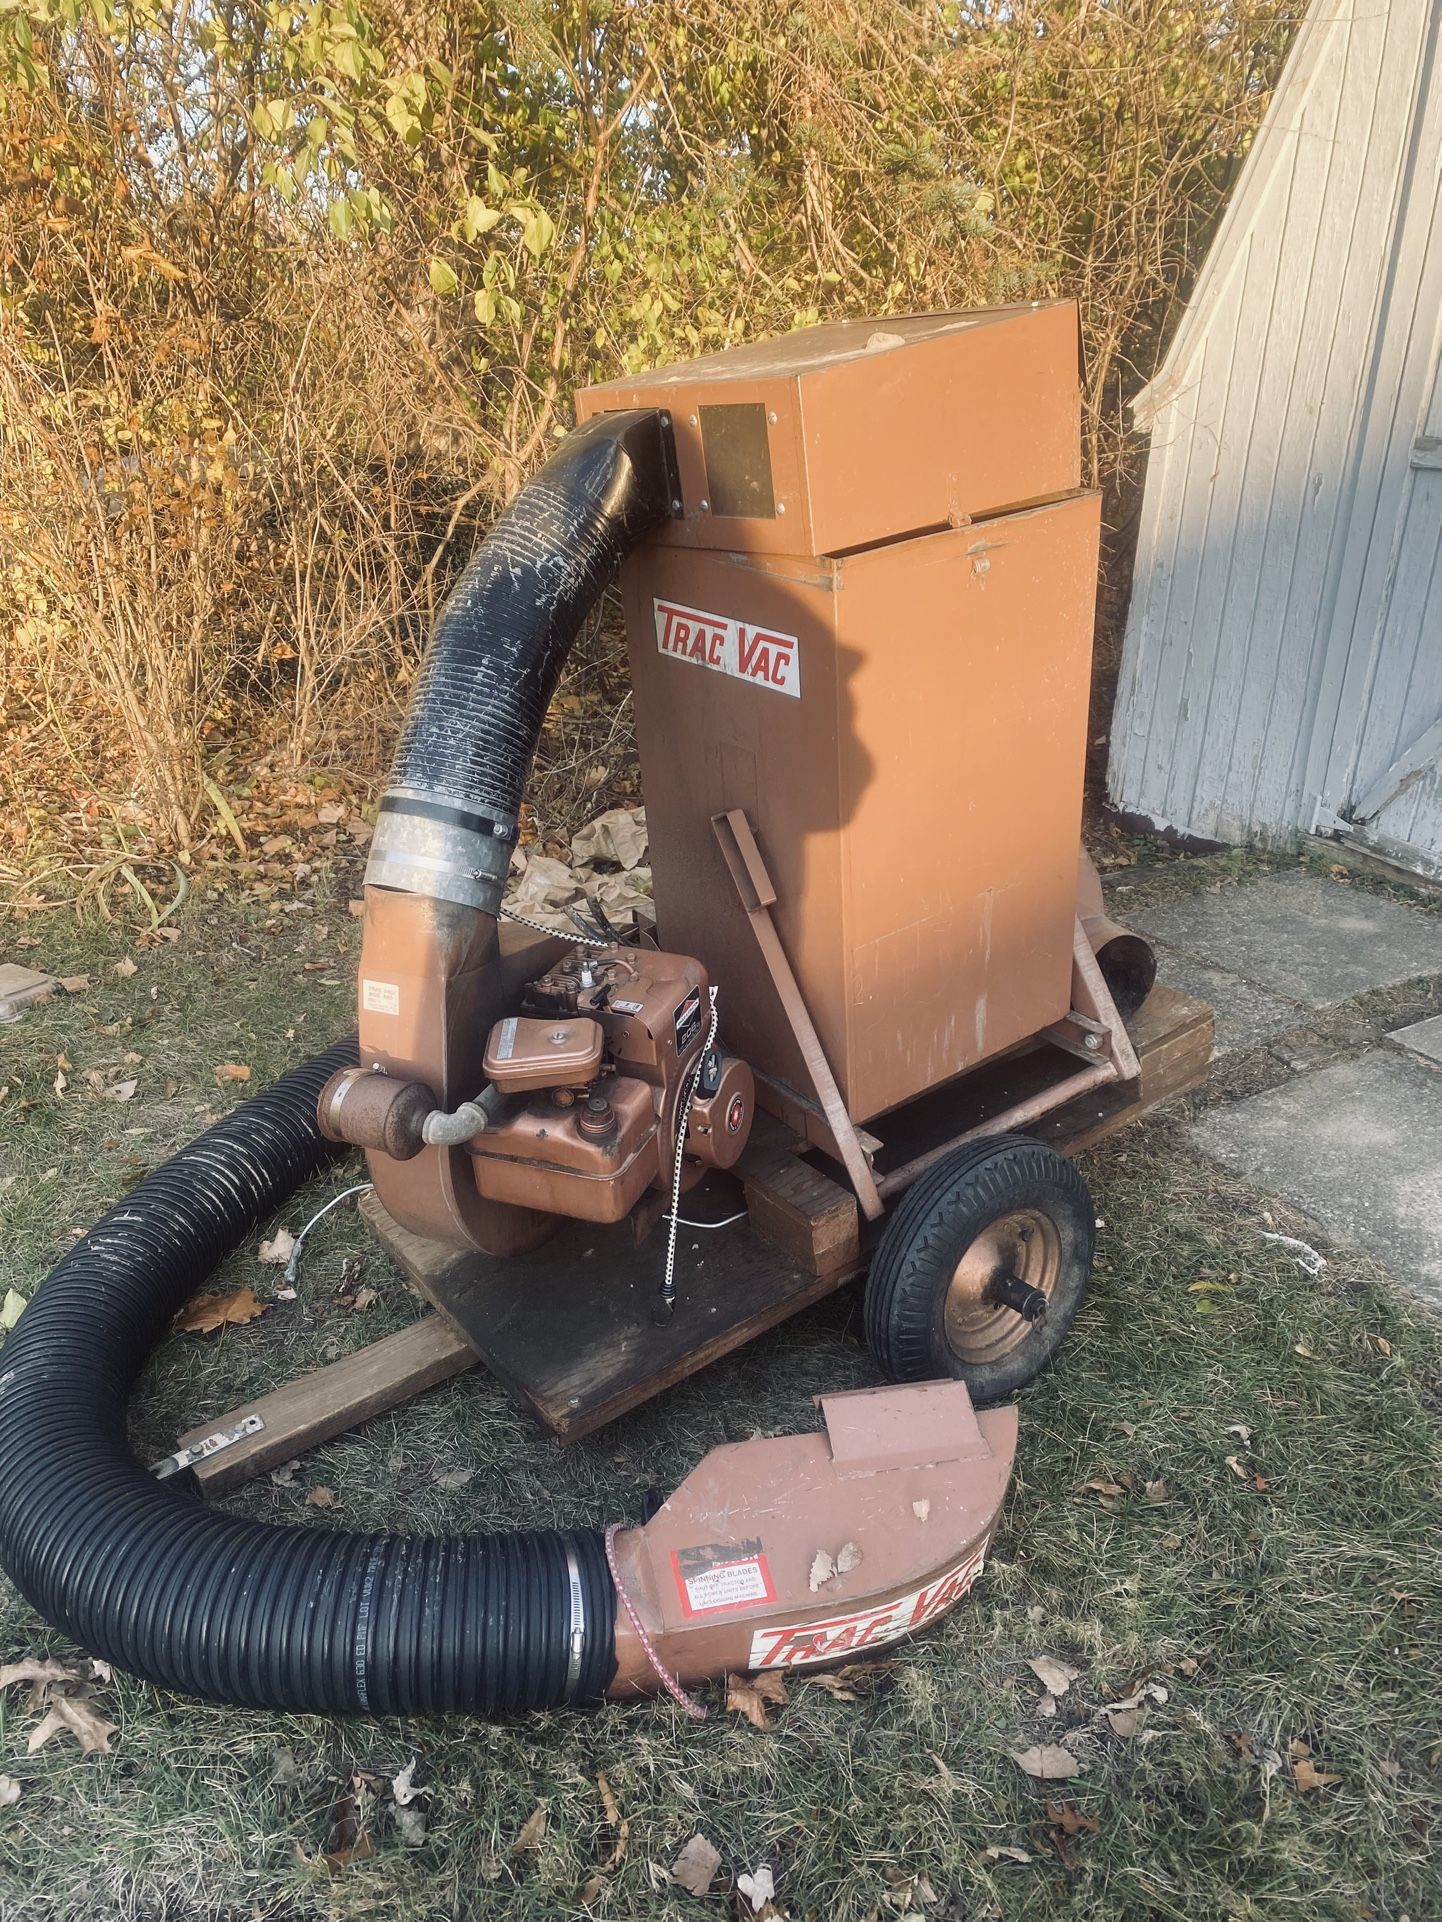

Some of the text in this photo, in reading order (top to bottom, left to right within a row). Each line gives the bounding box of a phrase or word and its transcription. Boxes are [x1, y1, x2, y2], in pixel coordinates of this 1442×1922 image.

[657, 604, 795, 686] TRAC VAC
[688, 1566, 758, 1585] SPINNING BLADES
